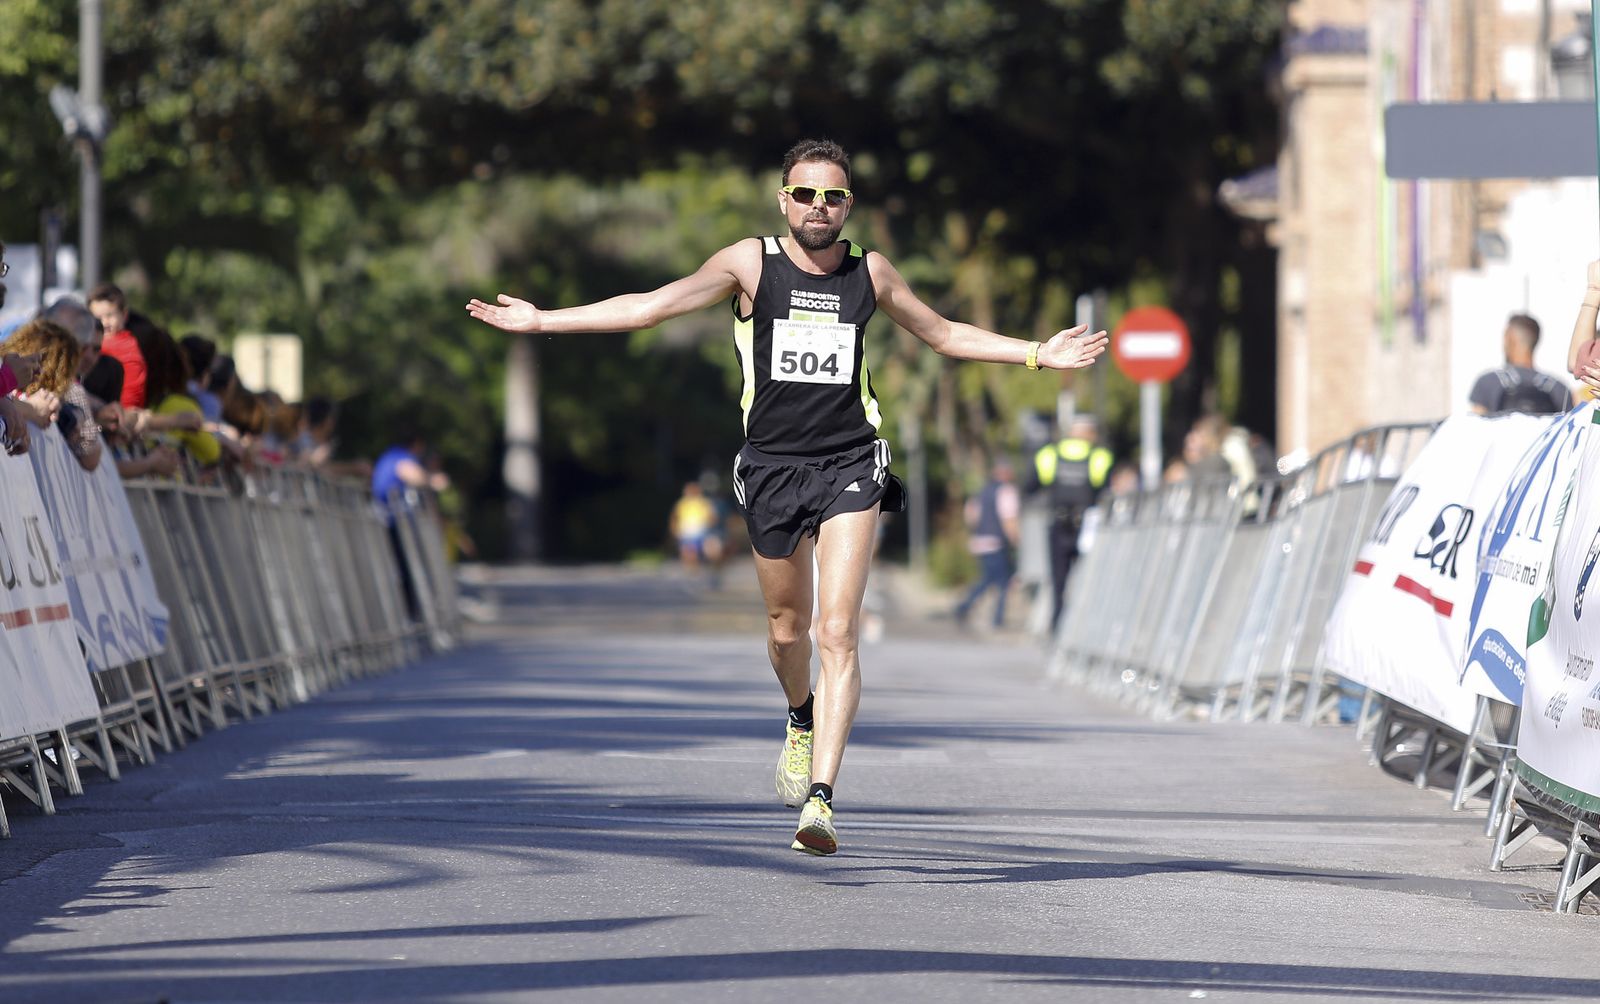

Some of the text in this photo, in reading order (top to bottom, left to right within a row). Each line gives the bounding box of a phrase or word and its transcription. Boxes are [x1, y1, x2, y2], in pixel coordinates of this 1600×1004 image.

[790, 289, 841, 302] CLUB DEPORTIVO
[790, 296, 841, 311] BESOCCER
[779, 350, 839, 377] 504
